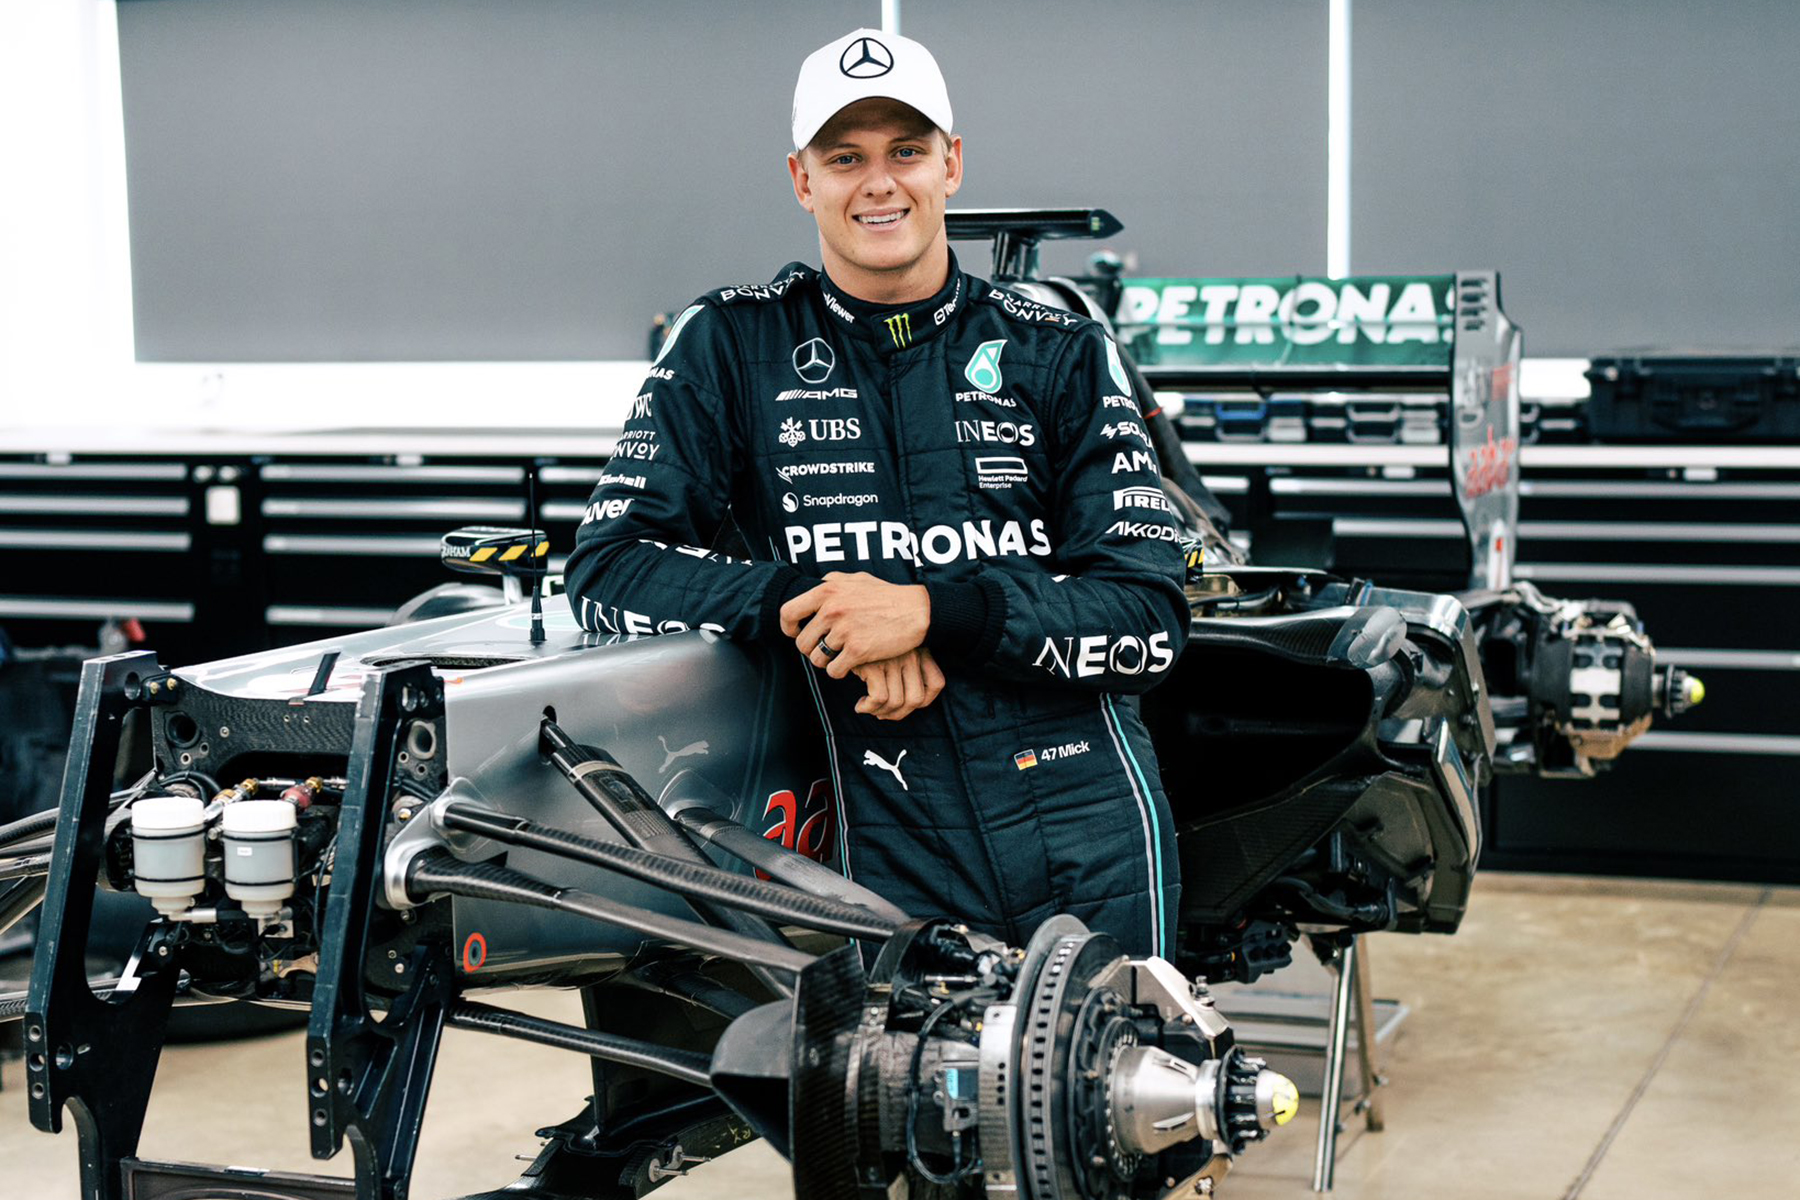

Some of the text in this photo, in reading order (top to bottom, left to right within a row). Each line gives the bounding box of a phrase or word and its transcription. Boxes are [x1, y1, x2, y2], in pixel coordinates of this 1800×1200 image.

[1116, 281, 1454, 345] PETRONA
[804, 388, 858, 400] AMG
[955, 390, 1017, 408] PETRONAS
[620, 430, 656, 441] RRIOTT
[808, 417, 862, 441] UBS
[954, 420, 1036, 447] INEOS
[610, 441, 660, 461] NVOY
[781, 462, 875, 478] CROWDSTRIKE
[1111, 450, 1158, 475] AM
[803, 493, 879, 508] Snapdragon
[1113, 485, 1173, 515] PIREL
[784, 518, 1052, 567] PETRONAS
[1041, 740, 1091, 761] 47 Mick
